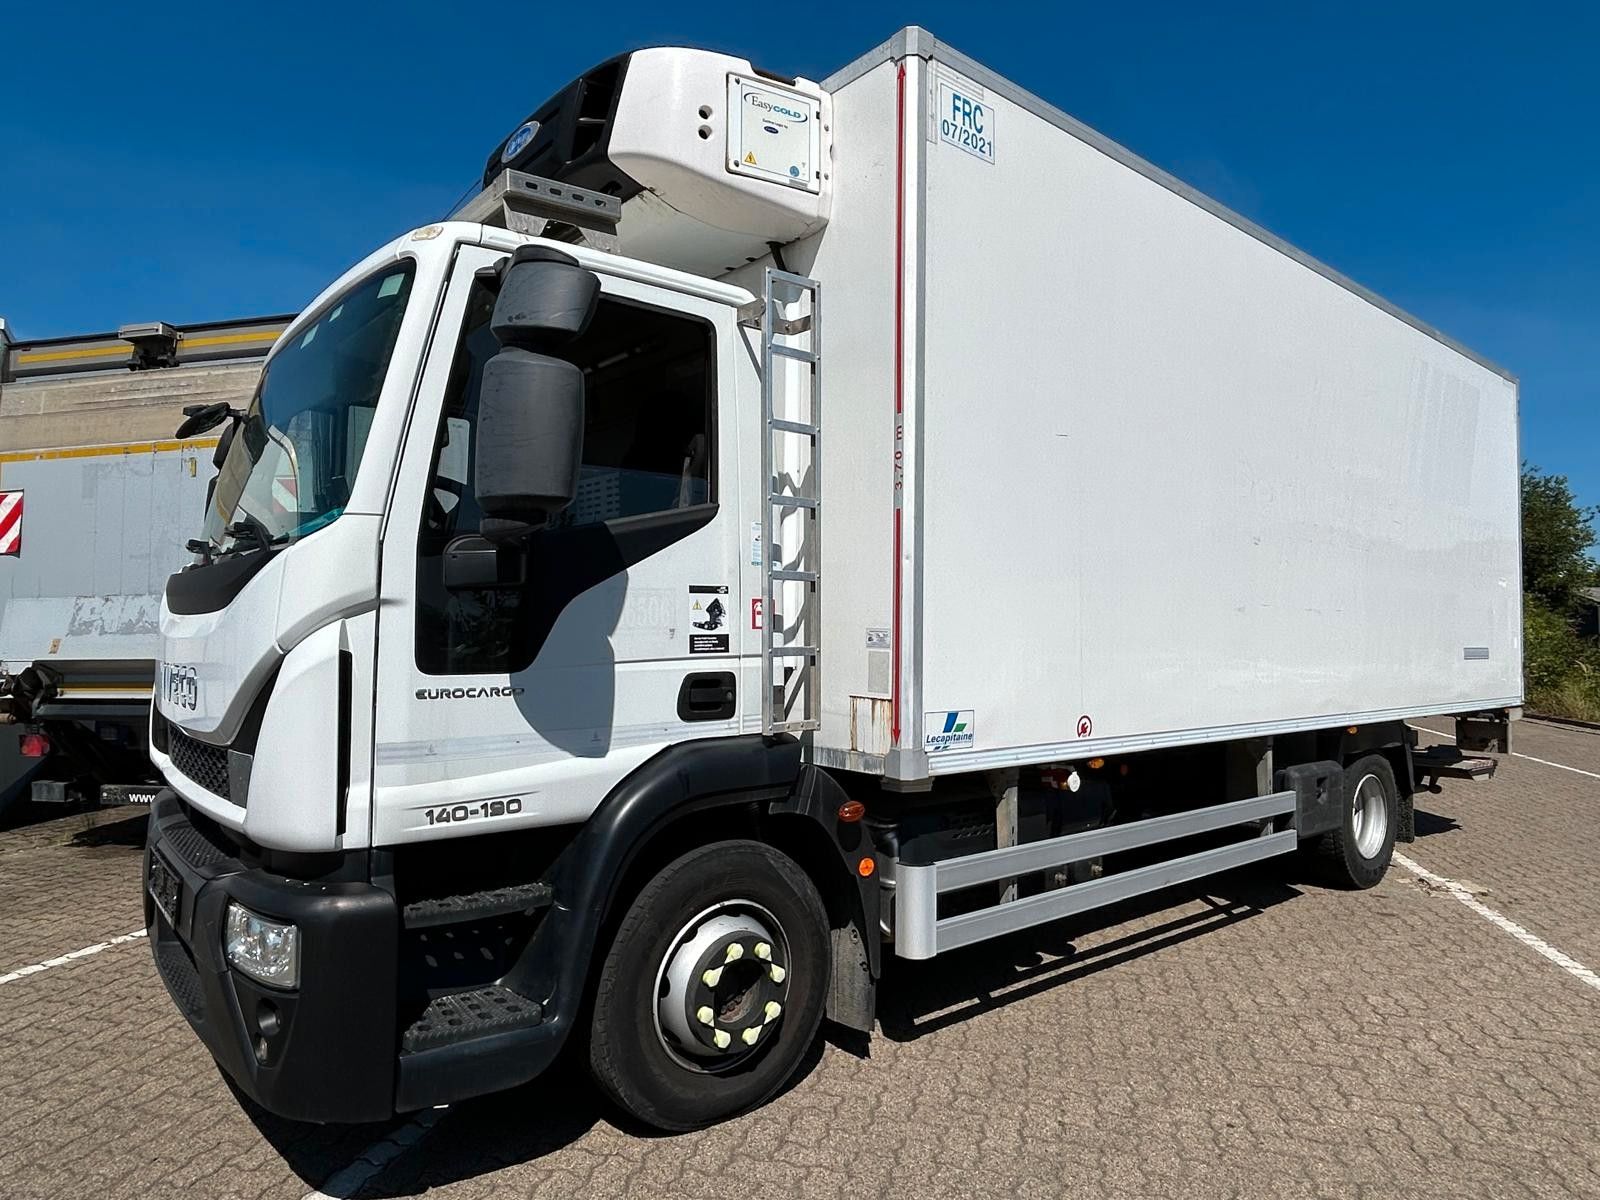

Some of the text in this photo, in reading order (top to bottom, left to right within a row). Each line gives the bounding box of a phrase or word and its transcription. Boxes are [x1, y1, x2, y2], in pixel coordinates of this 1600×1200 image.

[751, 95, 801, 119] EasyCOLD
[952, 93, 984, 134] FRC
[942, 119, 992, 157] 07/2021
[894, 425, 903, 490] 3.70 m
[415, 687, 524, 700] EUROCARGO
[926, 733, 973, 745] Lecapitaine
